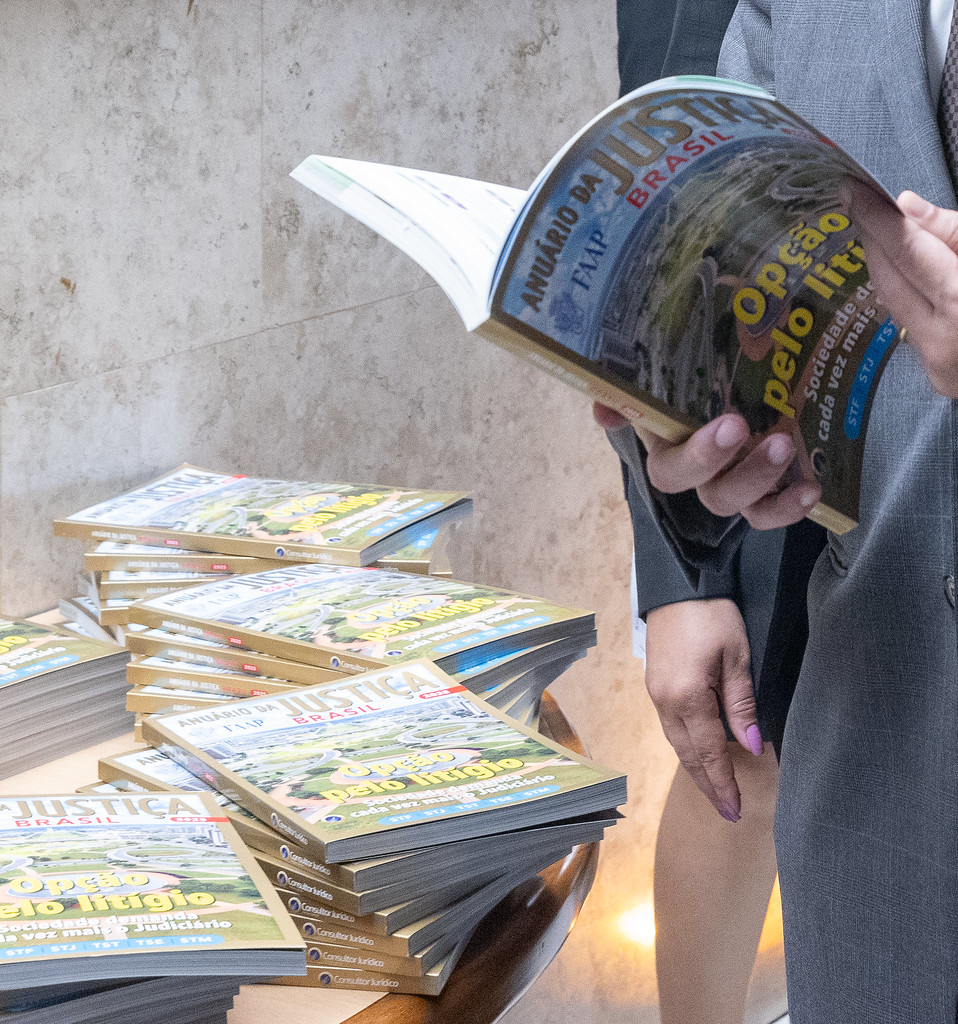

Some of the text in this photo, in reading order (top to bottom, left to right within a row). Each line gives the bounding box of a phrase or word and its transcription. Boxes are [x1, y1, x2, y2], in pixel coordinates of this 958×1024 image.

[626, 131, 734, 209] BRASIL
[521, 205, 579, 312] ANUÁRIO
[570, 174, 603, 204] DA
[572, 230, 608, 291] FAAP
[733, 213, 849, 325] Opção
[764, 307, 814, 418] pelo
[804, 302, 857, 402] Sociedade
[818, 395, 835, 441] cada
[828, 354, 848, 390] vez
[842, 306, 876, 353] mais
[848, 400, 859, 426] STF
[859, 357, 875, 383] STJ
[877, 322, 893, 343] TS
[178, 671, 440, 727] ANUÁRIO DA JUSTIÇA
[293, 704, 382, 724] BRASIL
[319, 758, 525, 804] pelo litígio
[337, 750, 456, 776] Opção
[12, 797, 202, 819] JUSTIÇA
[350, 805, 390, 818] cada
[390, 800, 421, 810] vez
[479, 775, 556, 795] Judiciário
[389, 787, 551, 823] STF STJ TST TSE STM
[15, 816, 120, 827] BRASIL
[10, 872, 149, 896] Opção
[0, 888, 216, 919] elo litígio
[105, 911, 199, 924] demanda
[5, 936, 212, 956] STF STJ TST TSE STM
[21, 931, 58, 940] vez
[62, 925, 112, 937] mais
[133, 919, 232, 933] Judiciário
[323, 951, 357, 964] Consultor
[334, 976, 370, 986] Consultor
